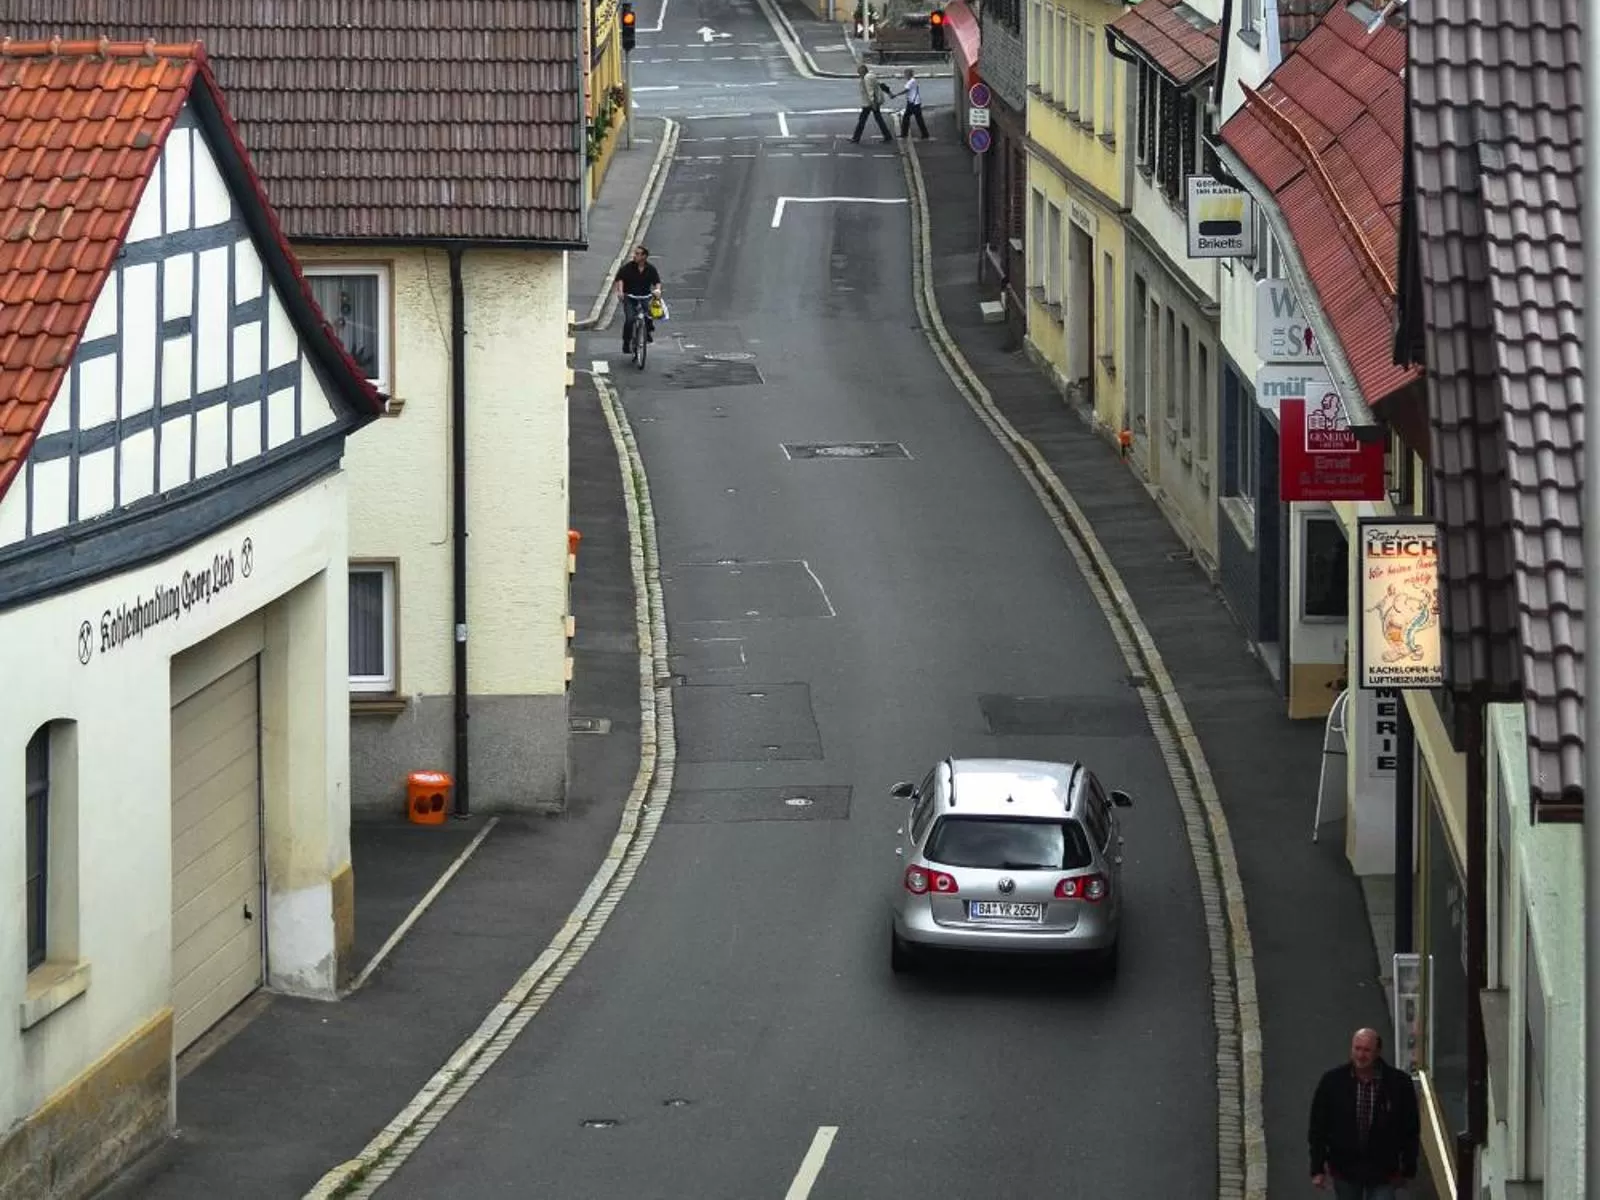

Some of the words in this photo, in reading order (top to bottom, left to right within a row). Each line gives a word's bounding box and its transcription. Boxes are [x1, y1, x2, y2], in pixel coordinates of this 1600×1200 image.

[1198, 238, 1242, 248] Briketts
[1270, 287, 1301, 318] W
[100, 584, 180, 652] Kohlenhandlung
[181, 569, 211, 613] Georg
[1369, 676, 1441, 684] LUFTHEIZUNGSB
[1376, 688, 1397, 770] MERIE
